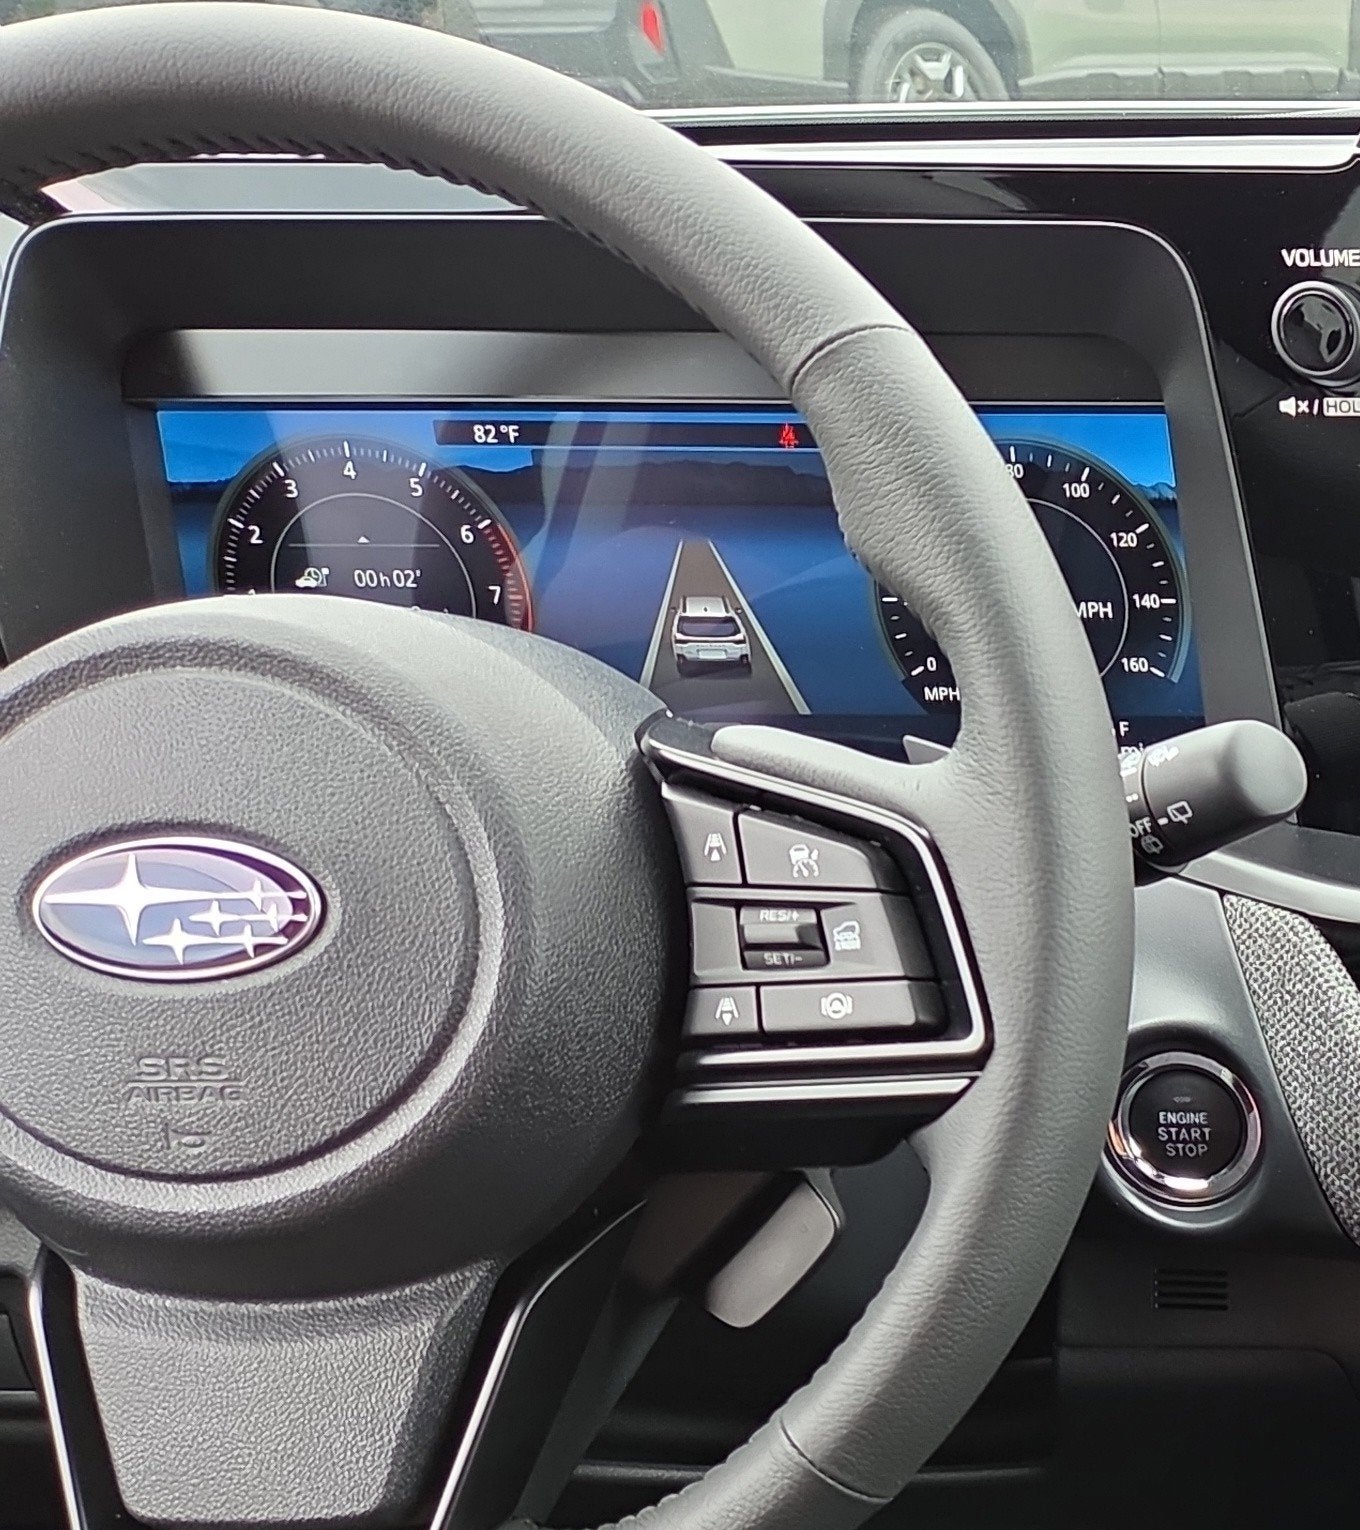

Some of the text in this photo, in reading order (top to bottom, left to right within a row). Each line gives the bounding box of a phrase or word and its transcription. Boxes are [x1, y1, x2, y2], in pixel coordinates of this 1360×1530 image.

[472, 424, 519, 444] 82°F
[343, 460, 357, 480] 4
[283, 479, 299, 499] 3
[410, 478, 424, 498] 5
[1063, 483, 1090, 498] 100
[248, 525, 263, 545] 2
[460, 525, 475, 545] 6
[1110, 532, 1138, 548] 120
[489, 586, 503, 606] 7
[1132, 593, 1161, 610] 140
[1076, 601, 1113, 619] MPH
[926, 657, 937, 671] 0
[1121, 657, 1149, 673] 160
[923, 686, 960, 701] MPH
[1119, 721, 1129, 737] F
[1129, 816, 1152, 838] OFF
[136, 1056, 230, 1081] SRS
[125, 1085, 242, 1102] AIRBAG
[1158, 1111, 1208, 1125] ENGINE
[1157, 1127, 1212, 1142] START
[1166, 1143, 1208, 1158] STOP
